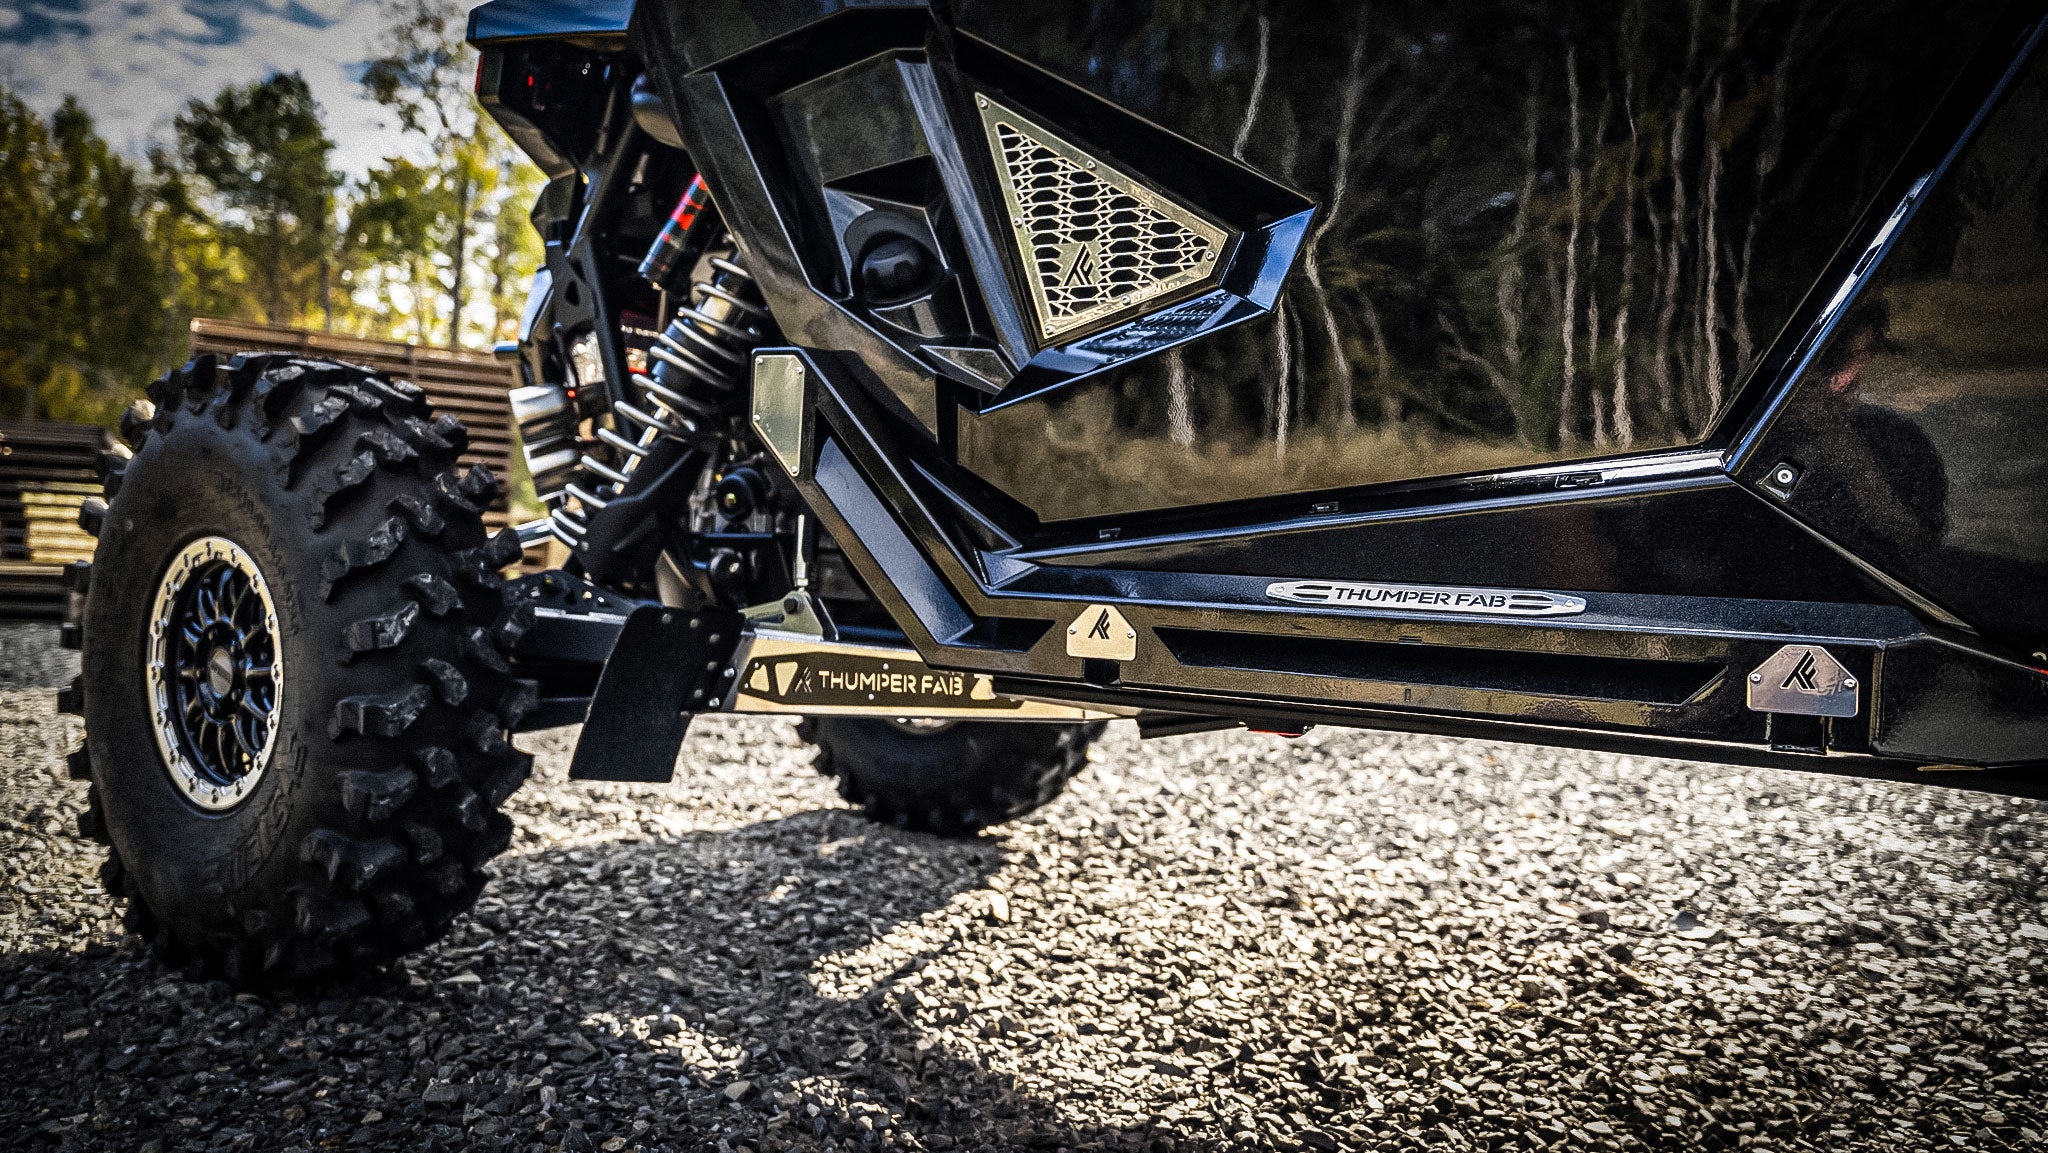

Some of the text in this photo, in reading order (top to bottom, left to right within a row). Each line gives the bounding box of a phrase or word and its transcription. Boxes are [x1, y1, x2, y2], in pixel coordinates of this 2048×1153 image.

[1335, 587, 1508, 607] THUMPER FAB
[818, 670, 916, 694] THUMPER
[921, 675, 964, 696] FAB
